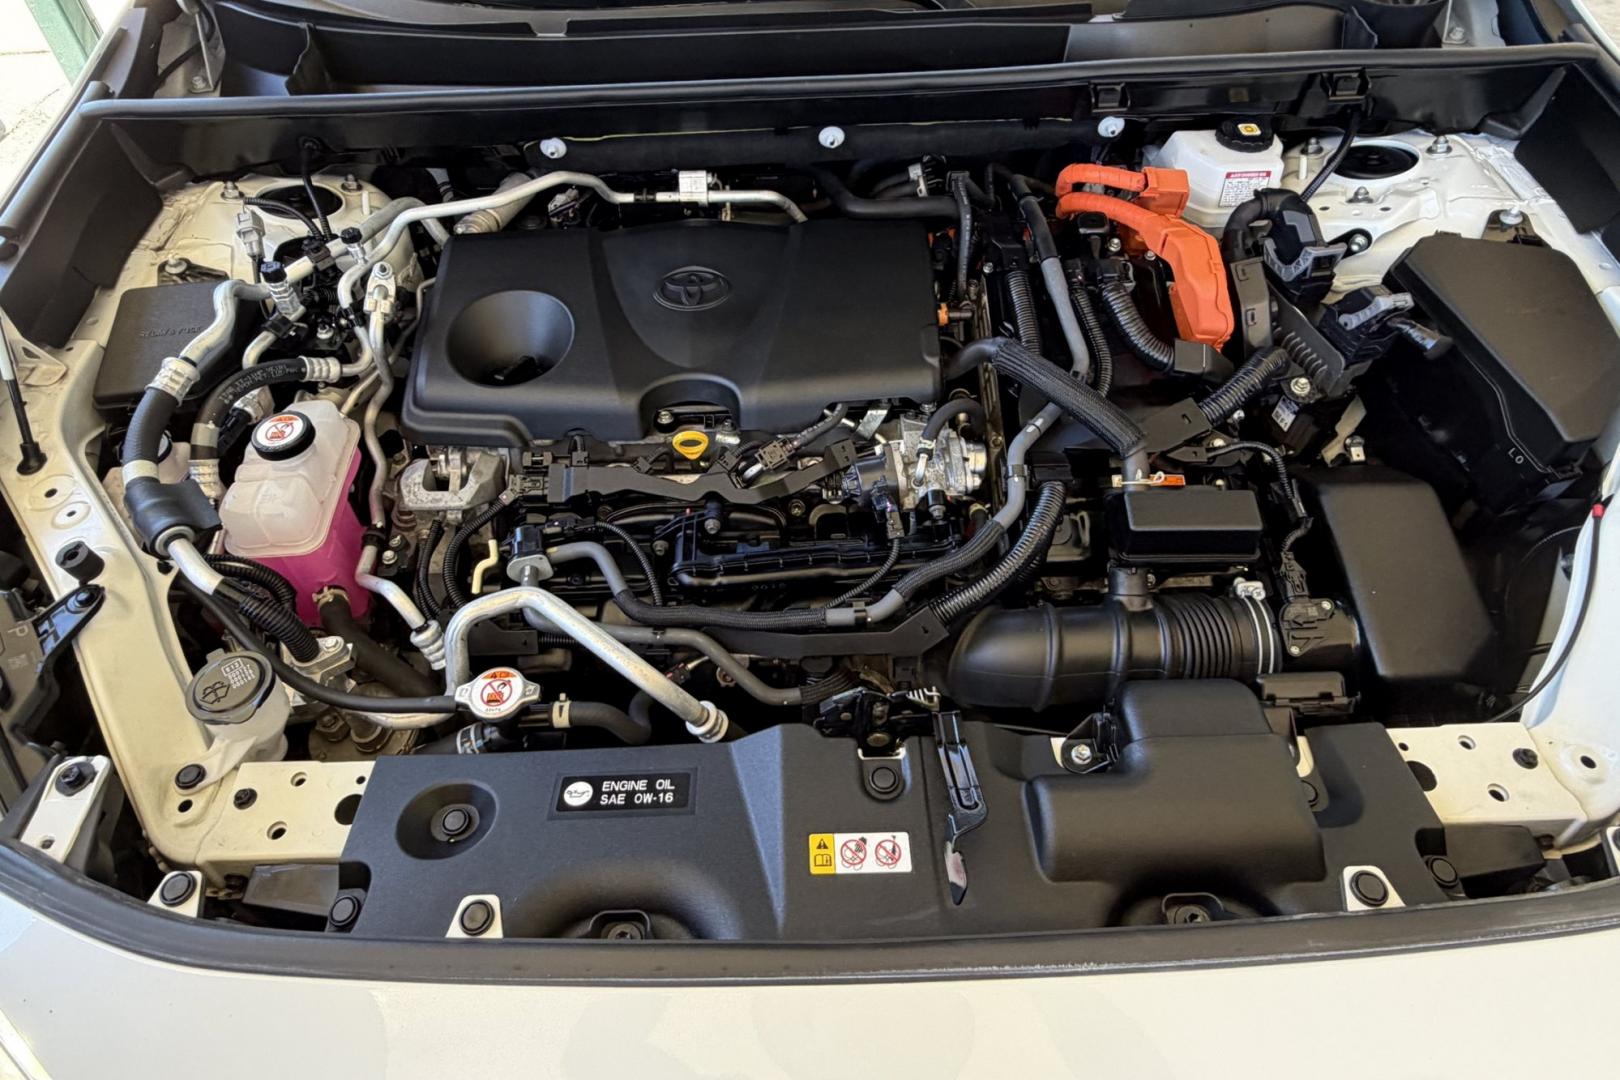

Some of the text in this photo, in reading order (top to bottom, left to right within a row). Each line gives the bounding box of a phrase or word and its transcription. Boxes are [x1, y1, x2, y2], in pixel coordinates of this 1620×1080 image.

[1508, 447, 1524, 464] LO
[601, 779, 675, 792] ENGINE OIL
[600, 792, 674, 805] SAE 0W-16
